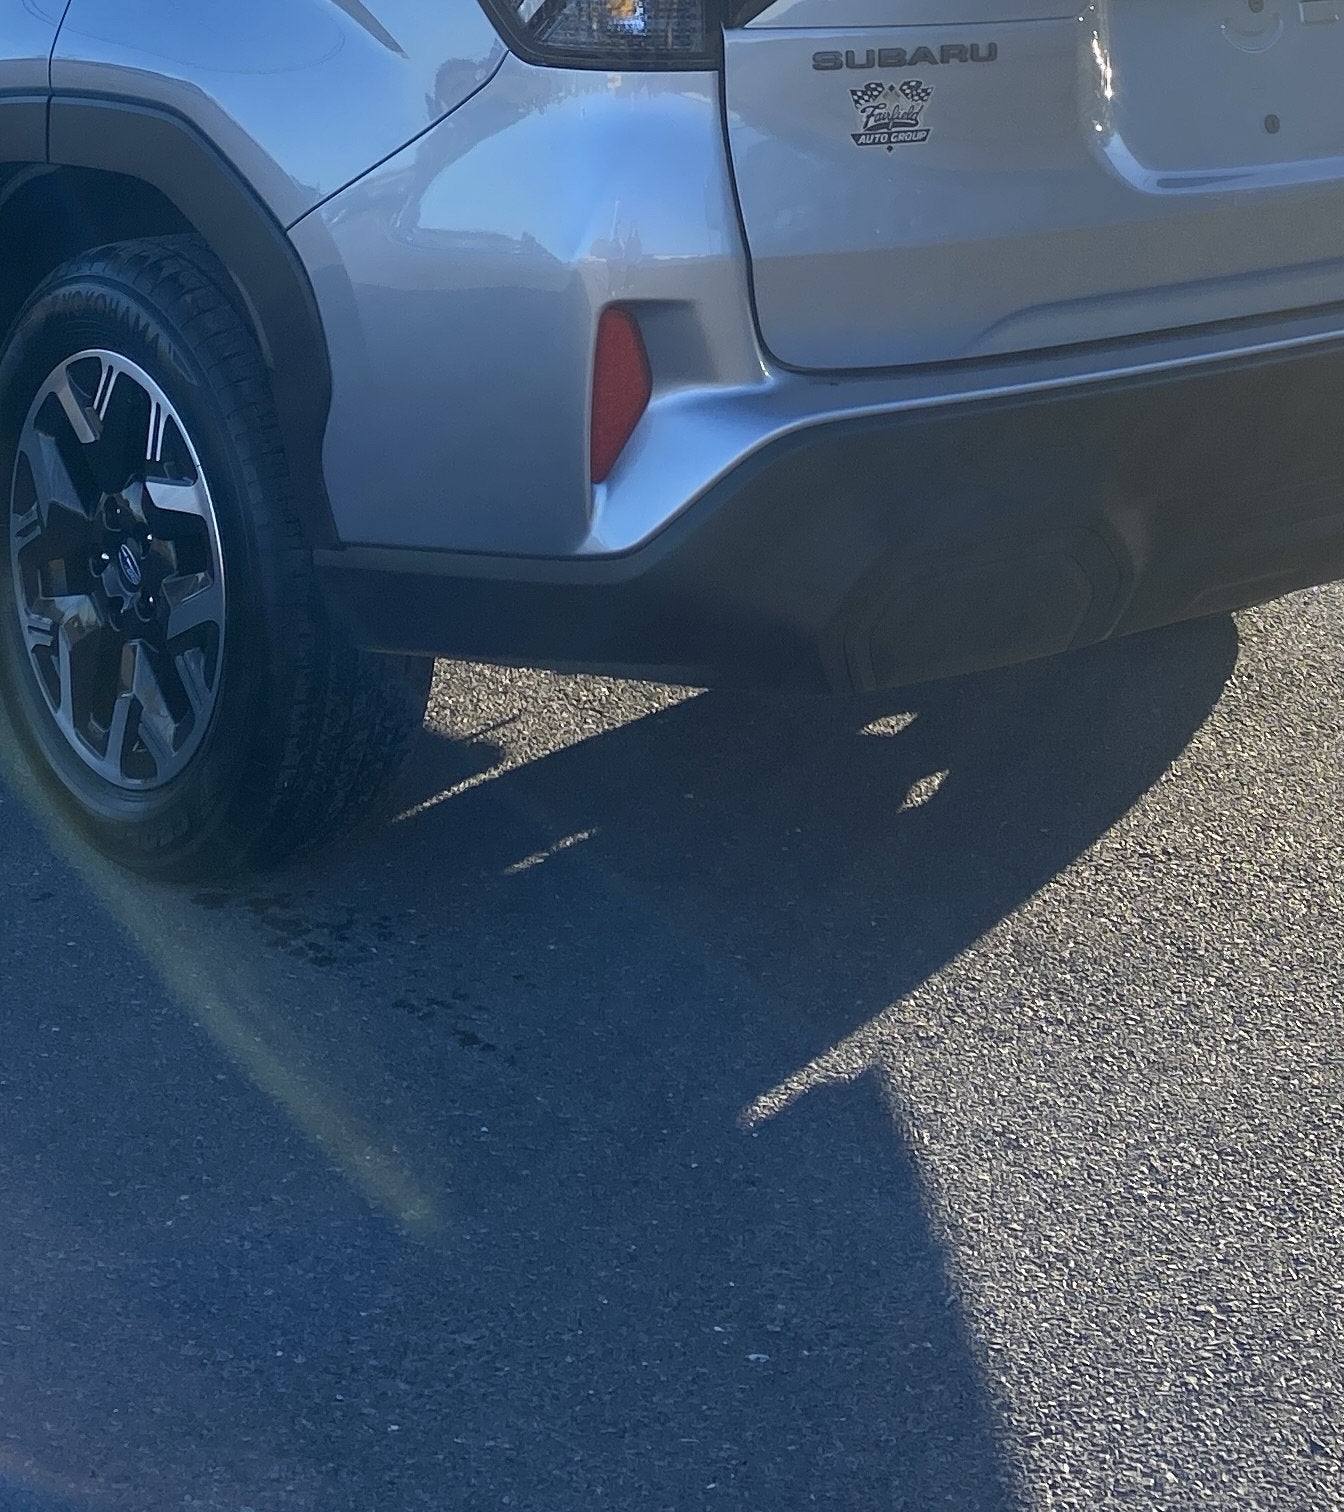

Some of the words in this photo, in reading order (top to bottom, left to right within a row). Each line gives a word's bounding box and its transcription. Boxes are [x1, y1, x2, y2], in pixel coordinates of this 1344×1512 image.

[812, 42, 998, 71] SUBARU
[860, 102, 924, 131] Fairfield
[857, 133, 888, 144] AUTO
[890, 131, 927, 142] GROUP
[62, 290, 161, 360] YOKOHAMA
